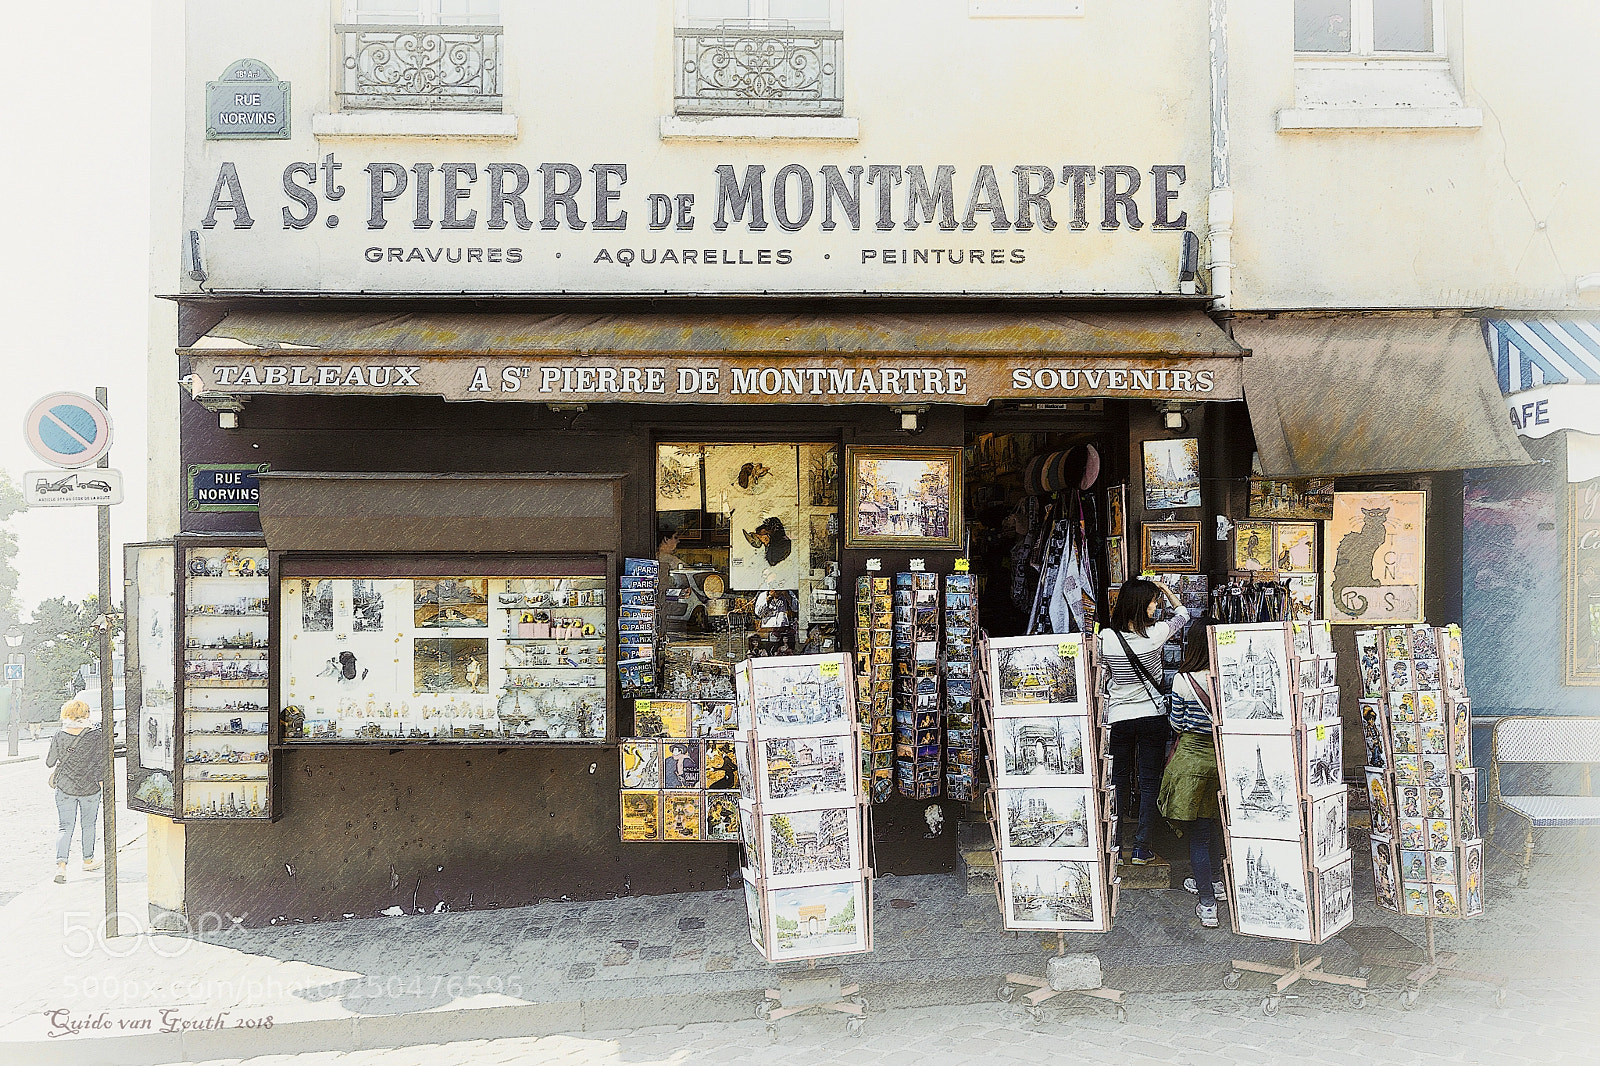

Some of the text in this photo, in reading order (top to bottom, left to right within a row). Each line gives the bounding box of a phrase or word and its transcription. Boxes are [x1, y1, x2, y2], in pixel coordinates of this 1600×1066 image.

[234, 93, 261, 107] RUE
[219, 112, 276, 125] NORVINS
[200, 162, 255, 230] A
[363, 162, 629, 231] PIERRE
[648, 193, 696, 231] DE
[712, 163, 1188, 233] MONTMARTRE
[364, 247, 1027, 267] GRAVURES AQUARELLES PEINTURES
[213, 365, 421, 388] TABLEAUX
[467, 366, 492, 393] A
[539, 366, 666, 394] PIERRE
[676, 367, 720, 395] DE
[731, 368, 968, 396] MONTMARTRE
[1011, 368, 1216, 393] SOUVENIRS
[215, 472, 242, 485] RUE
[198, 488, 259, 501] NORVINS
[637, 566, 658, 575] PARIS
[632, 580, 654, 588] PARIS
[632, 611, 653, 619] PARIS
[630, 623, 652, 631] PARIS
